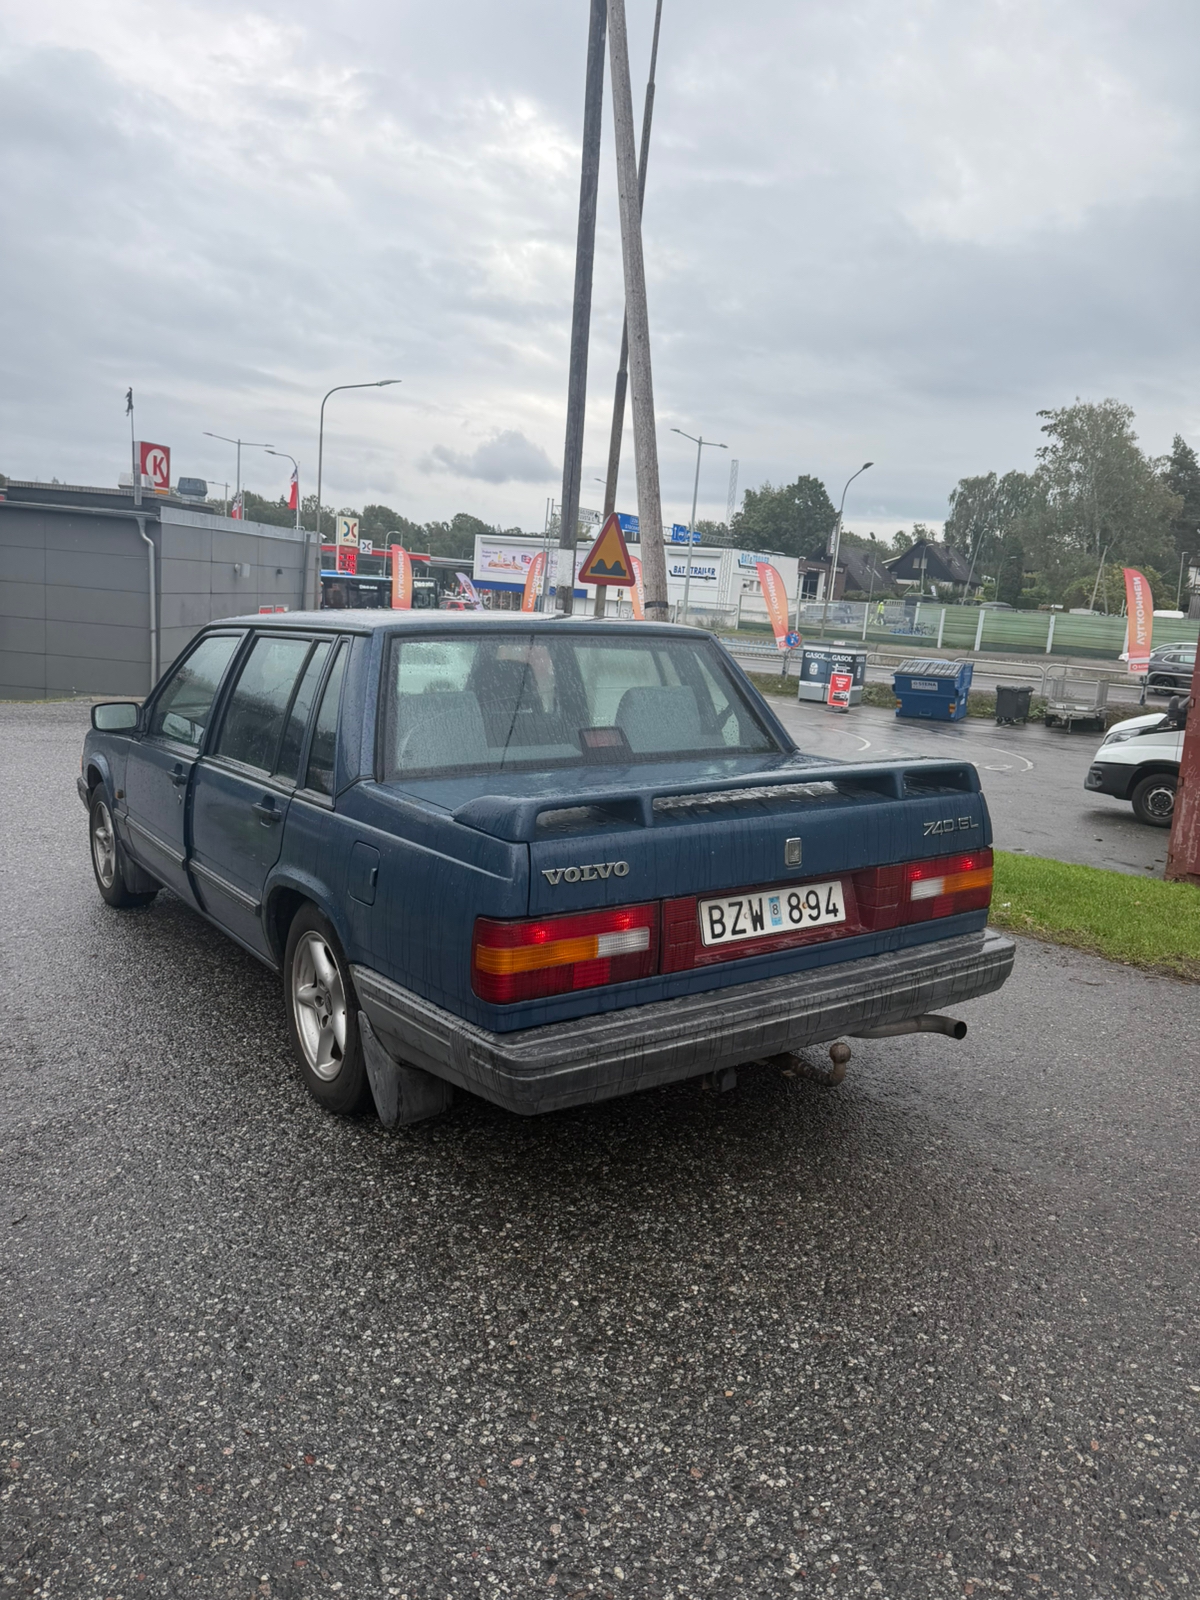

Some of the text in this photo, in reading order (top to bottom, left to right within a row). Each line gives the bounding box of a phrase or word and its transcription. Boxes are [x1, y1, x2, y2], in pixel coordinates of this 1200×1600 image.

[152, 455, 165, 483] K
[690, 566, 716, 576] TRAILER
[805, 651, 825, 660] GASOL
[831, 654, 854, 663] GASOL
[923, 815, 980, 837] 740 GL
[542, 860, 631, 885] VOLVO
[708, 886, 839, 939] BZW 894
[772, 903, 779, 916] 8
